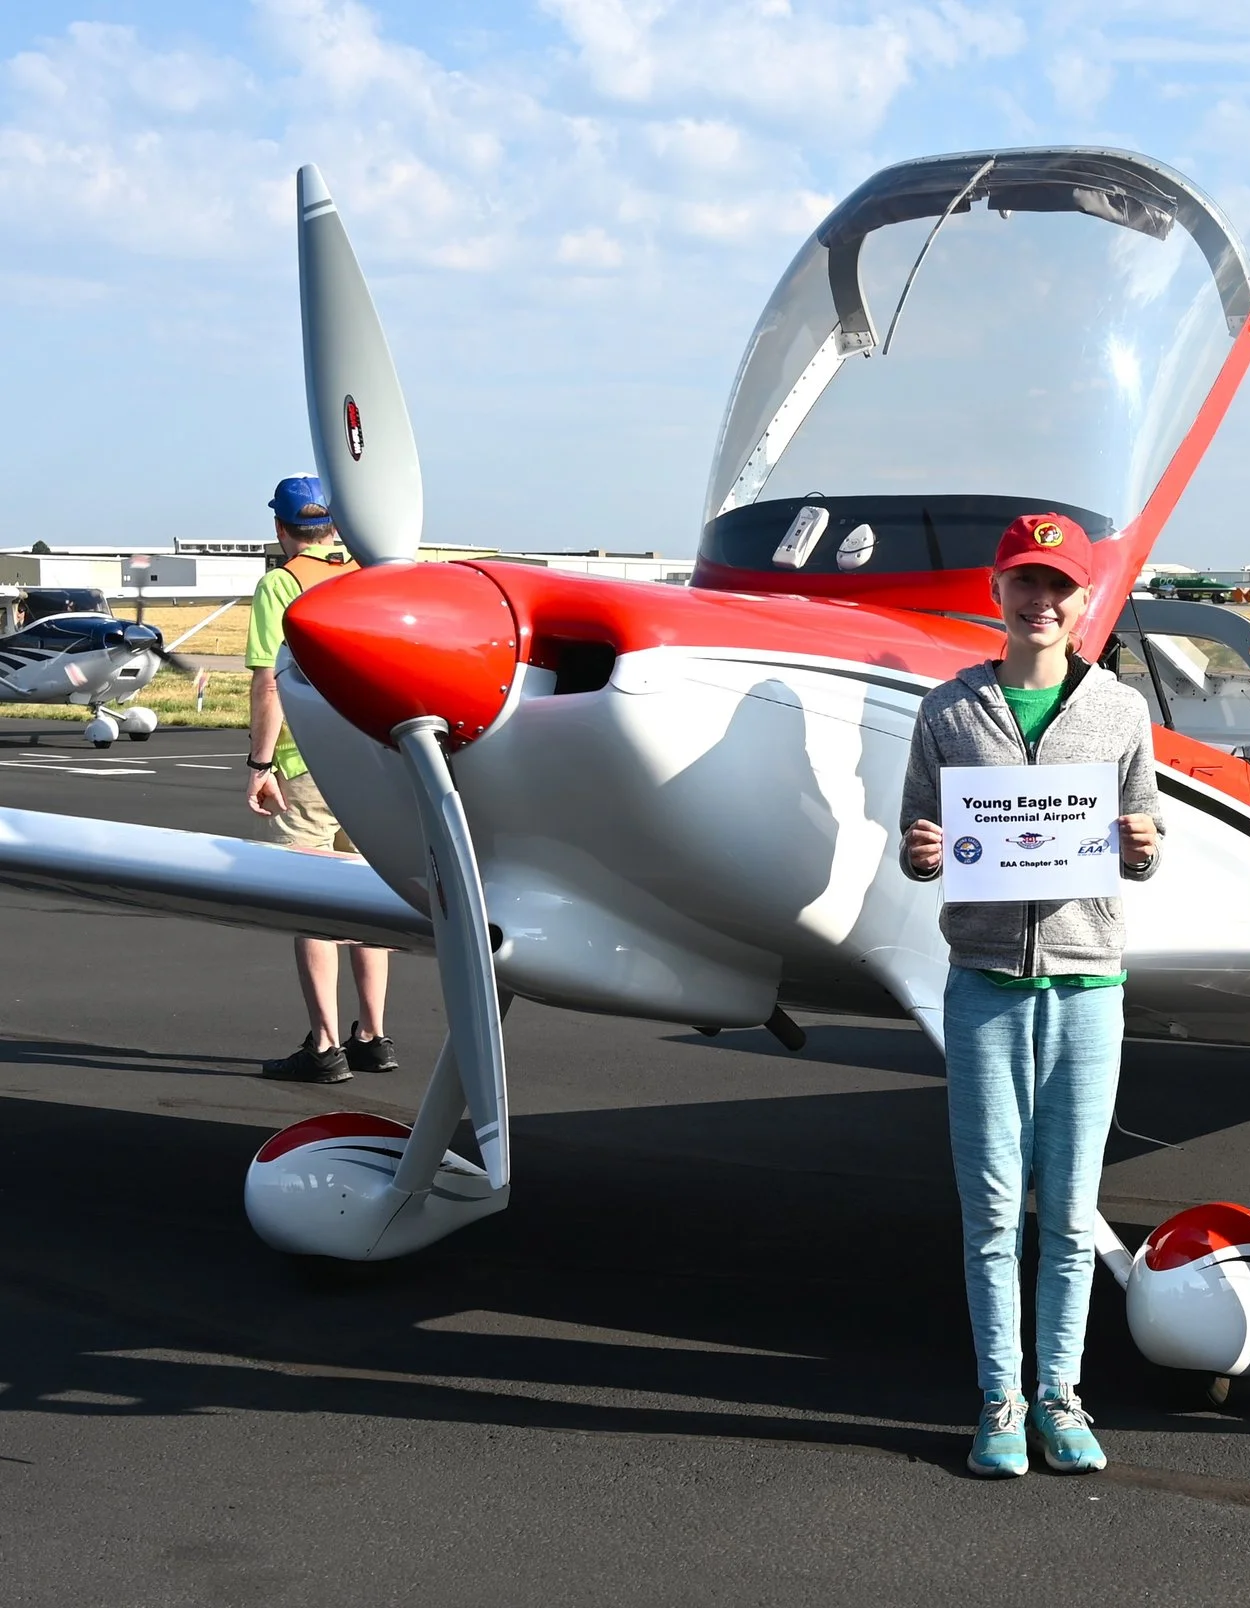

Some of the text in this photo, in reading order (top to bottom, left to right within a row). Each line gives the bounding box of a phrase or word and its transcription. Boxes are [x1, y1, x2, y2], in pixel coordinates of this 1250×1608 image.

[962, 795, 1098, 811] Young Eagle Day
[974, 811, 1086, 824] Centennial Airport
[1077, 845, 1103, 854] EAA
[1019, 860, 1052, 868] Chapter
[1053, 859, 1069, 867] 301
